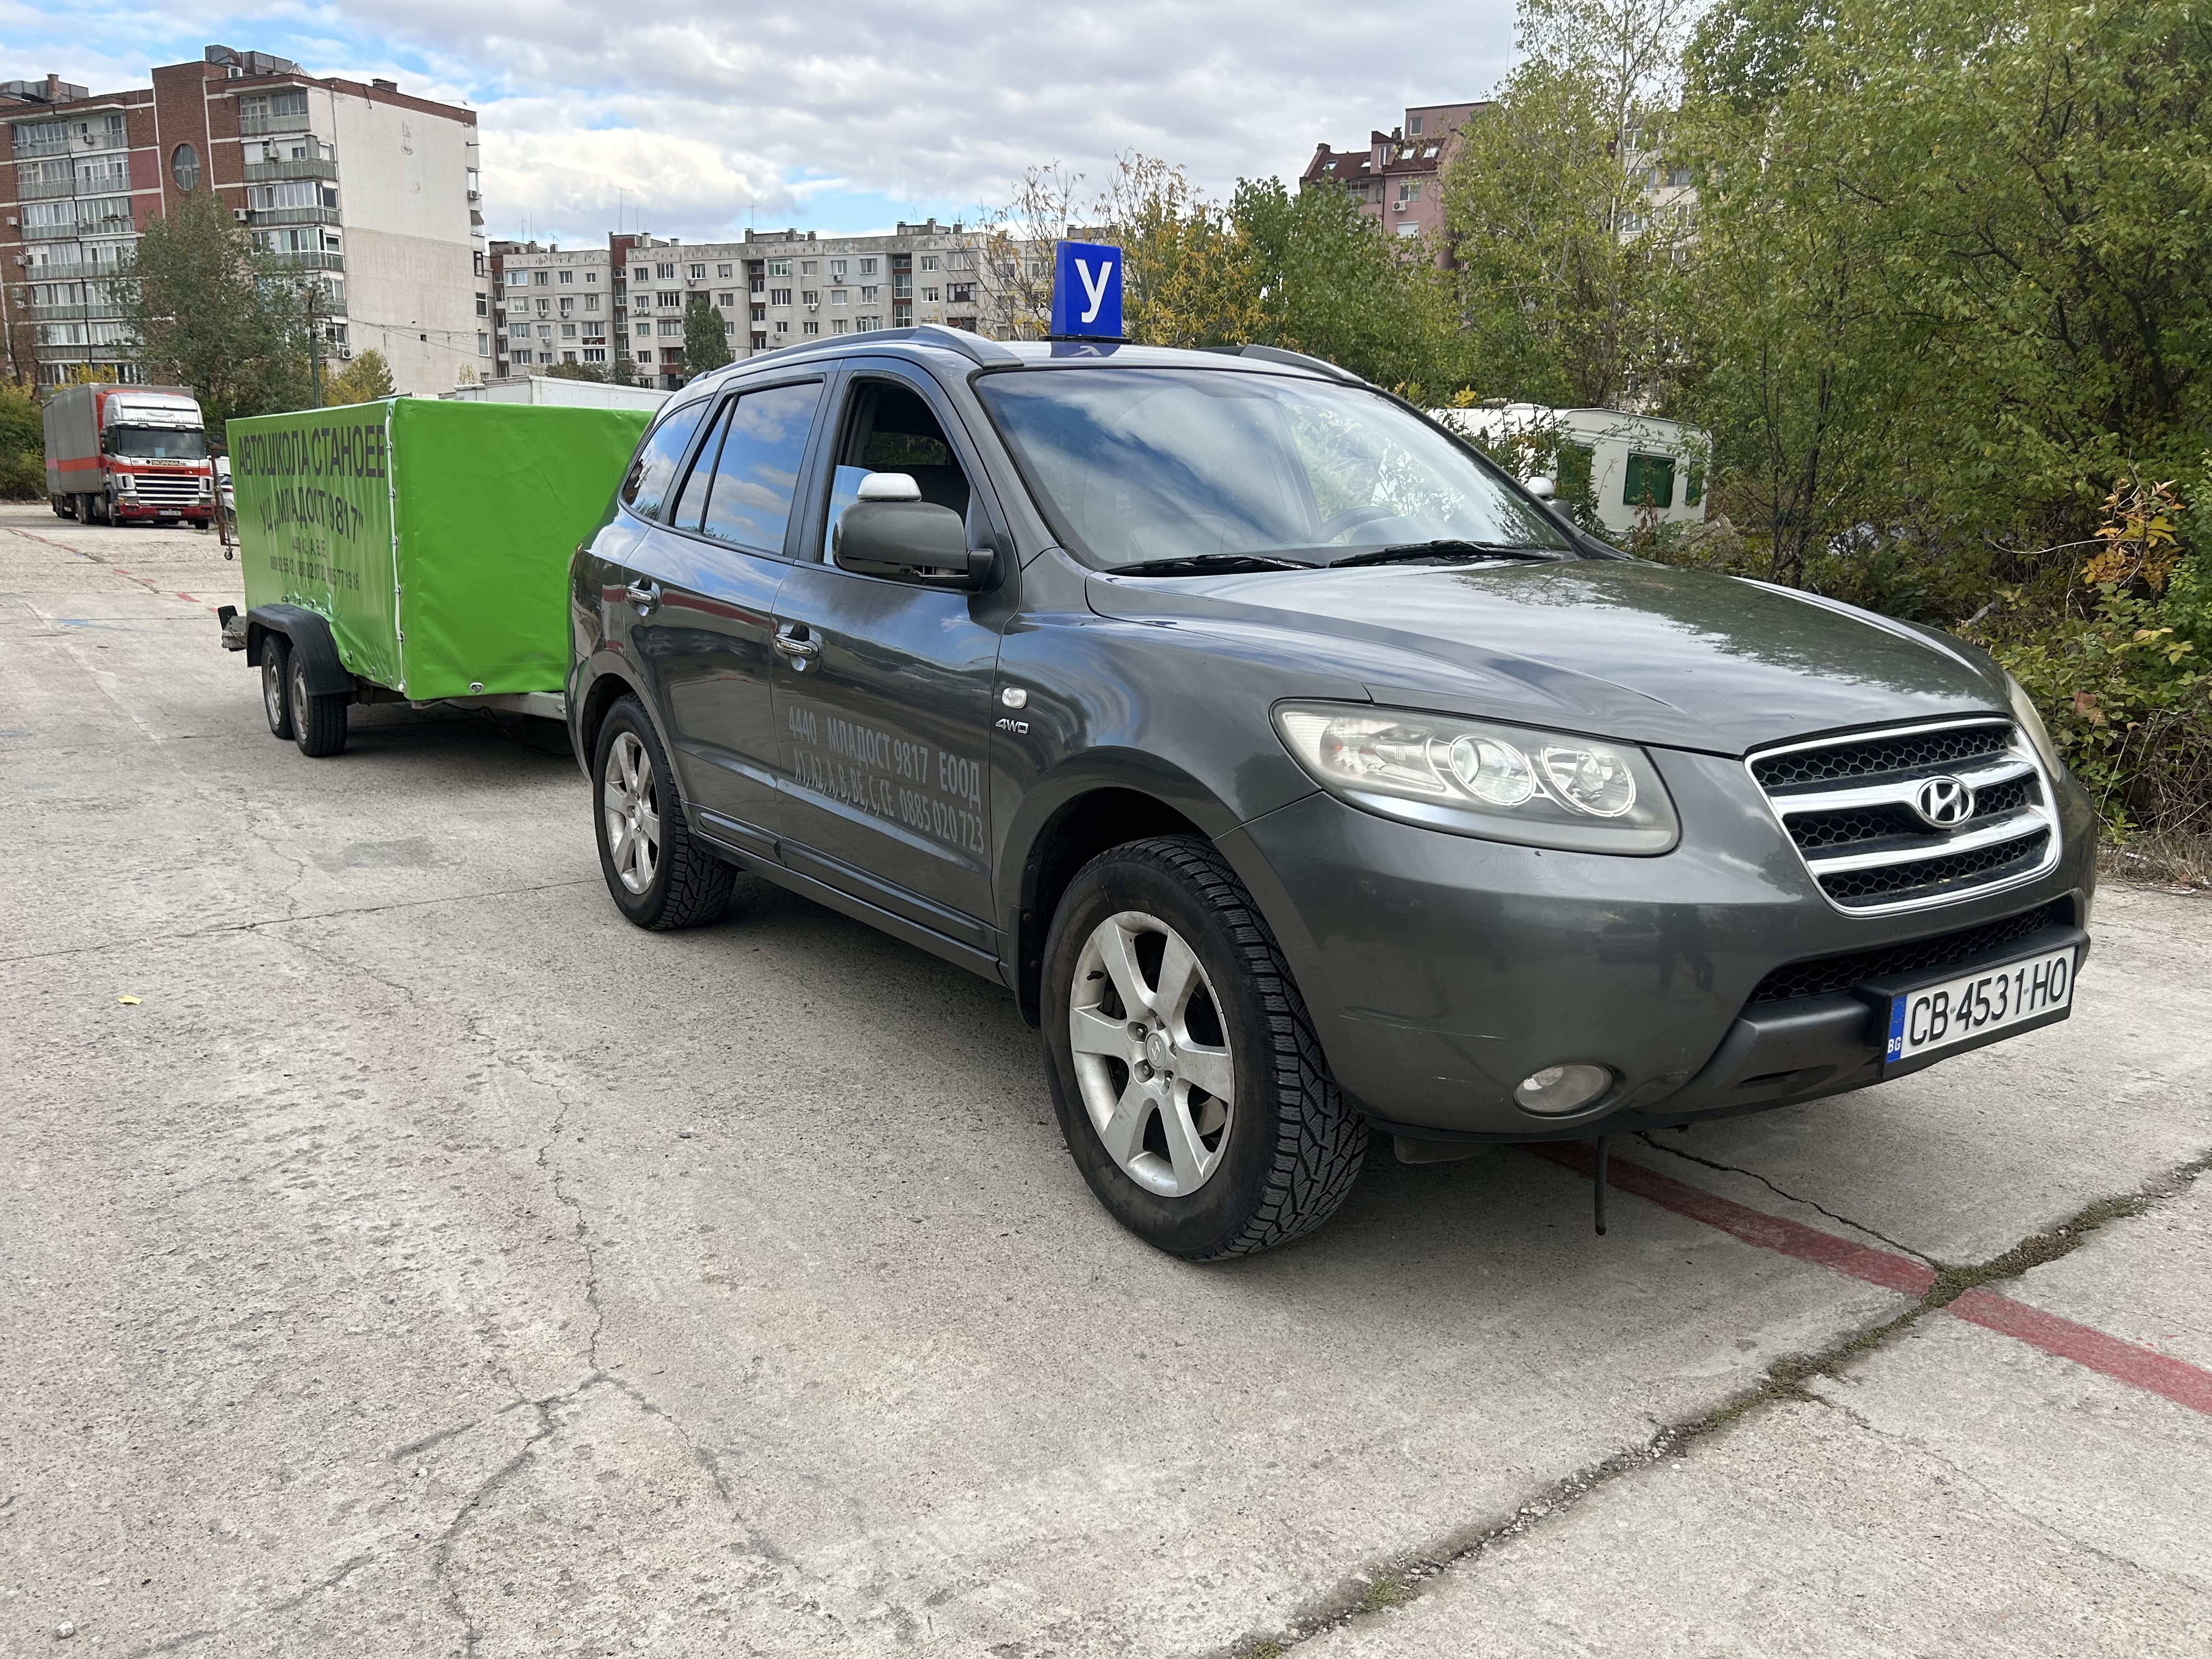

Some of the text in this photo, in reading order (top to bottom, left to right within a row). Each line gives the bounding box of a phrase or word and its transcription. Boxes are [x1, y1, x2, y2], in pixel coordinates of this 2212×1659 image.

[239, 430, 311, 476] АВТОШКОЛА
[995, 718, 1029, 734] 4WD
[789, 706, 981, 812] 4440 МЛАДОСТ 9817 ЕООД
[900, 787, 930, 832] 0885
[933, 800, 957, 843] 020
[959, 809, 984, 854] 723
[1887, 1036, 1901, 1053] BG
